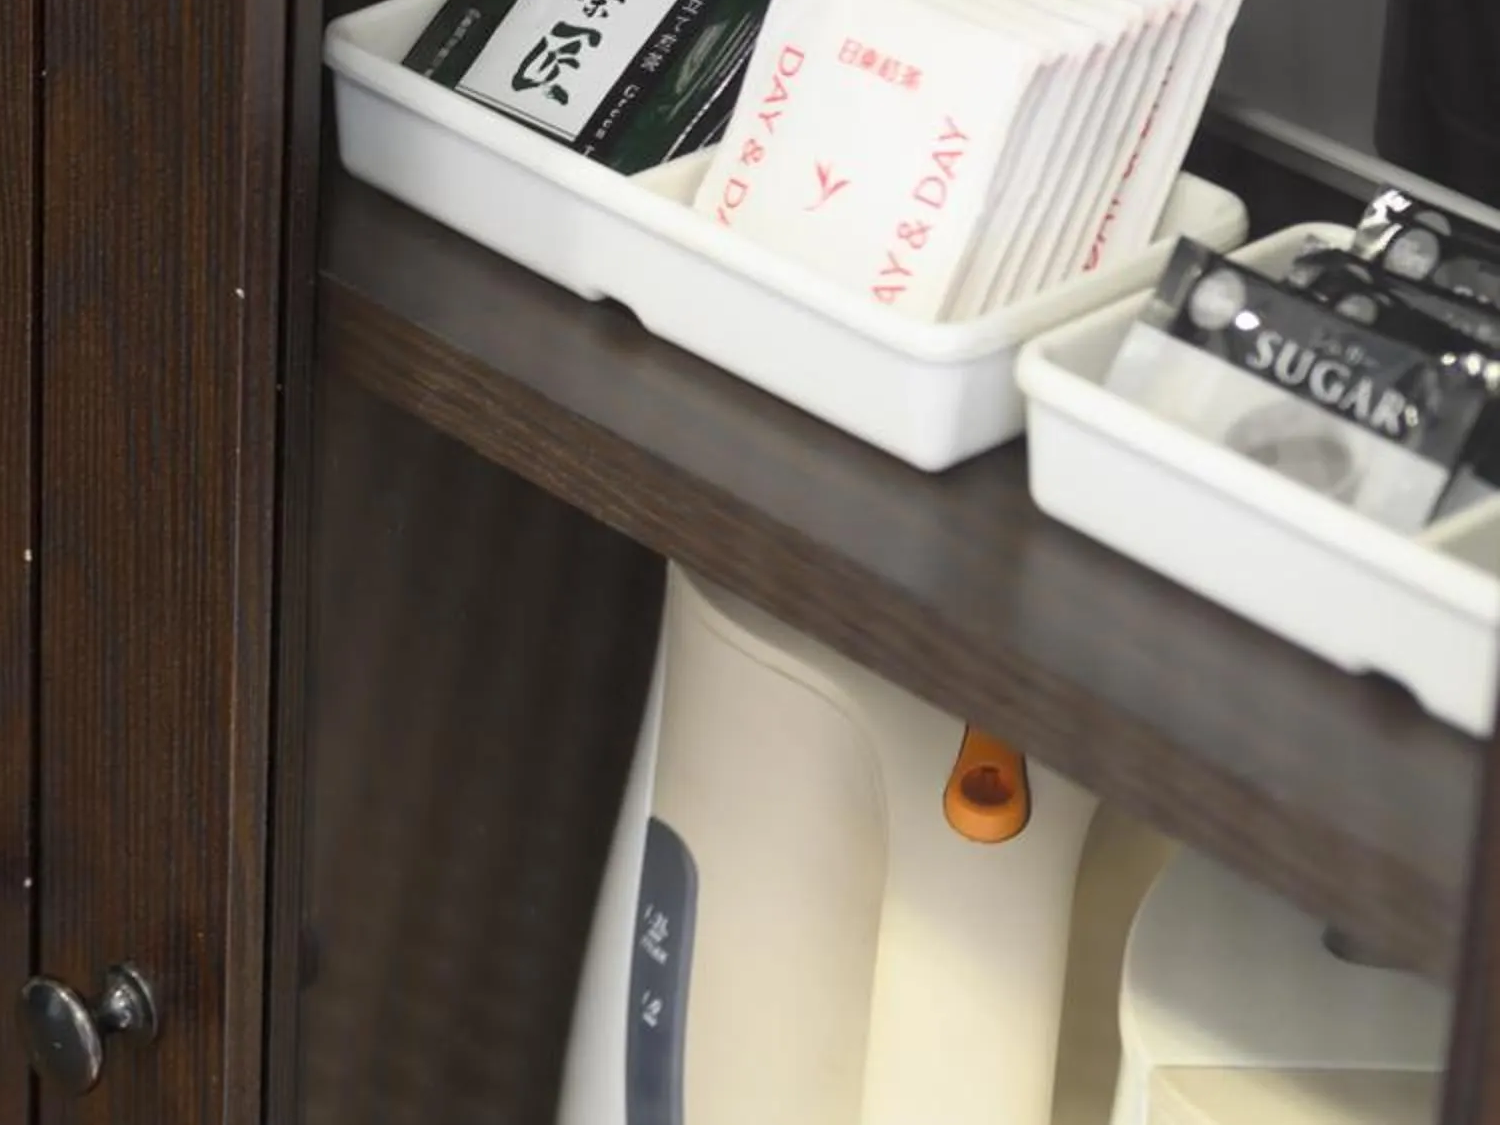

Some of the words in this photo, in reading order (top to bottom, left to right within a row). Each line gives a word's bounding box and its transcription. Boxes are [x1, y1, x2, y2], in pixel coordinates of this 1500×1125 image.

[758, 45, 805, 136] DAY
[740, 138, 765, 166] &
[912, 115, 969, 210] DAY
[897, 219, 932, 251] &
[871, 249, 914, 304] AY
[1246, 330, 1408, 435] SUGAR
